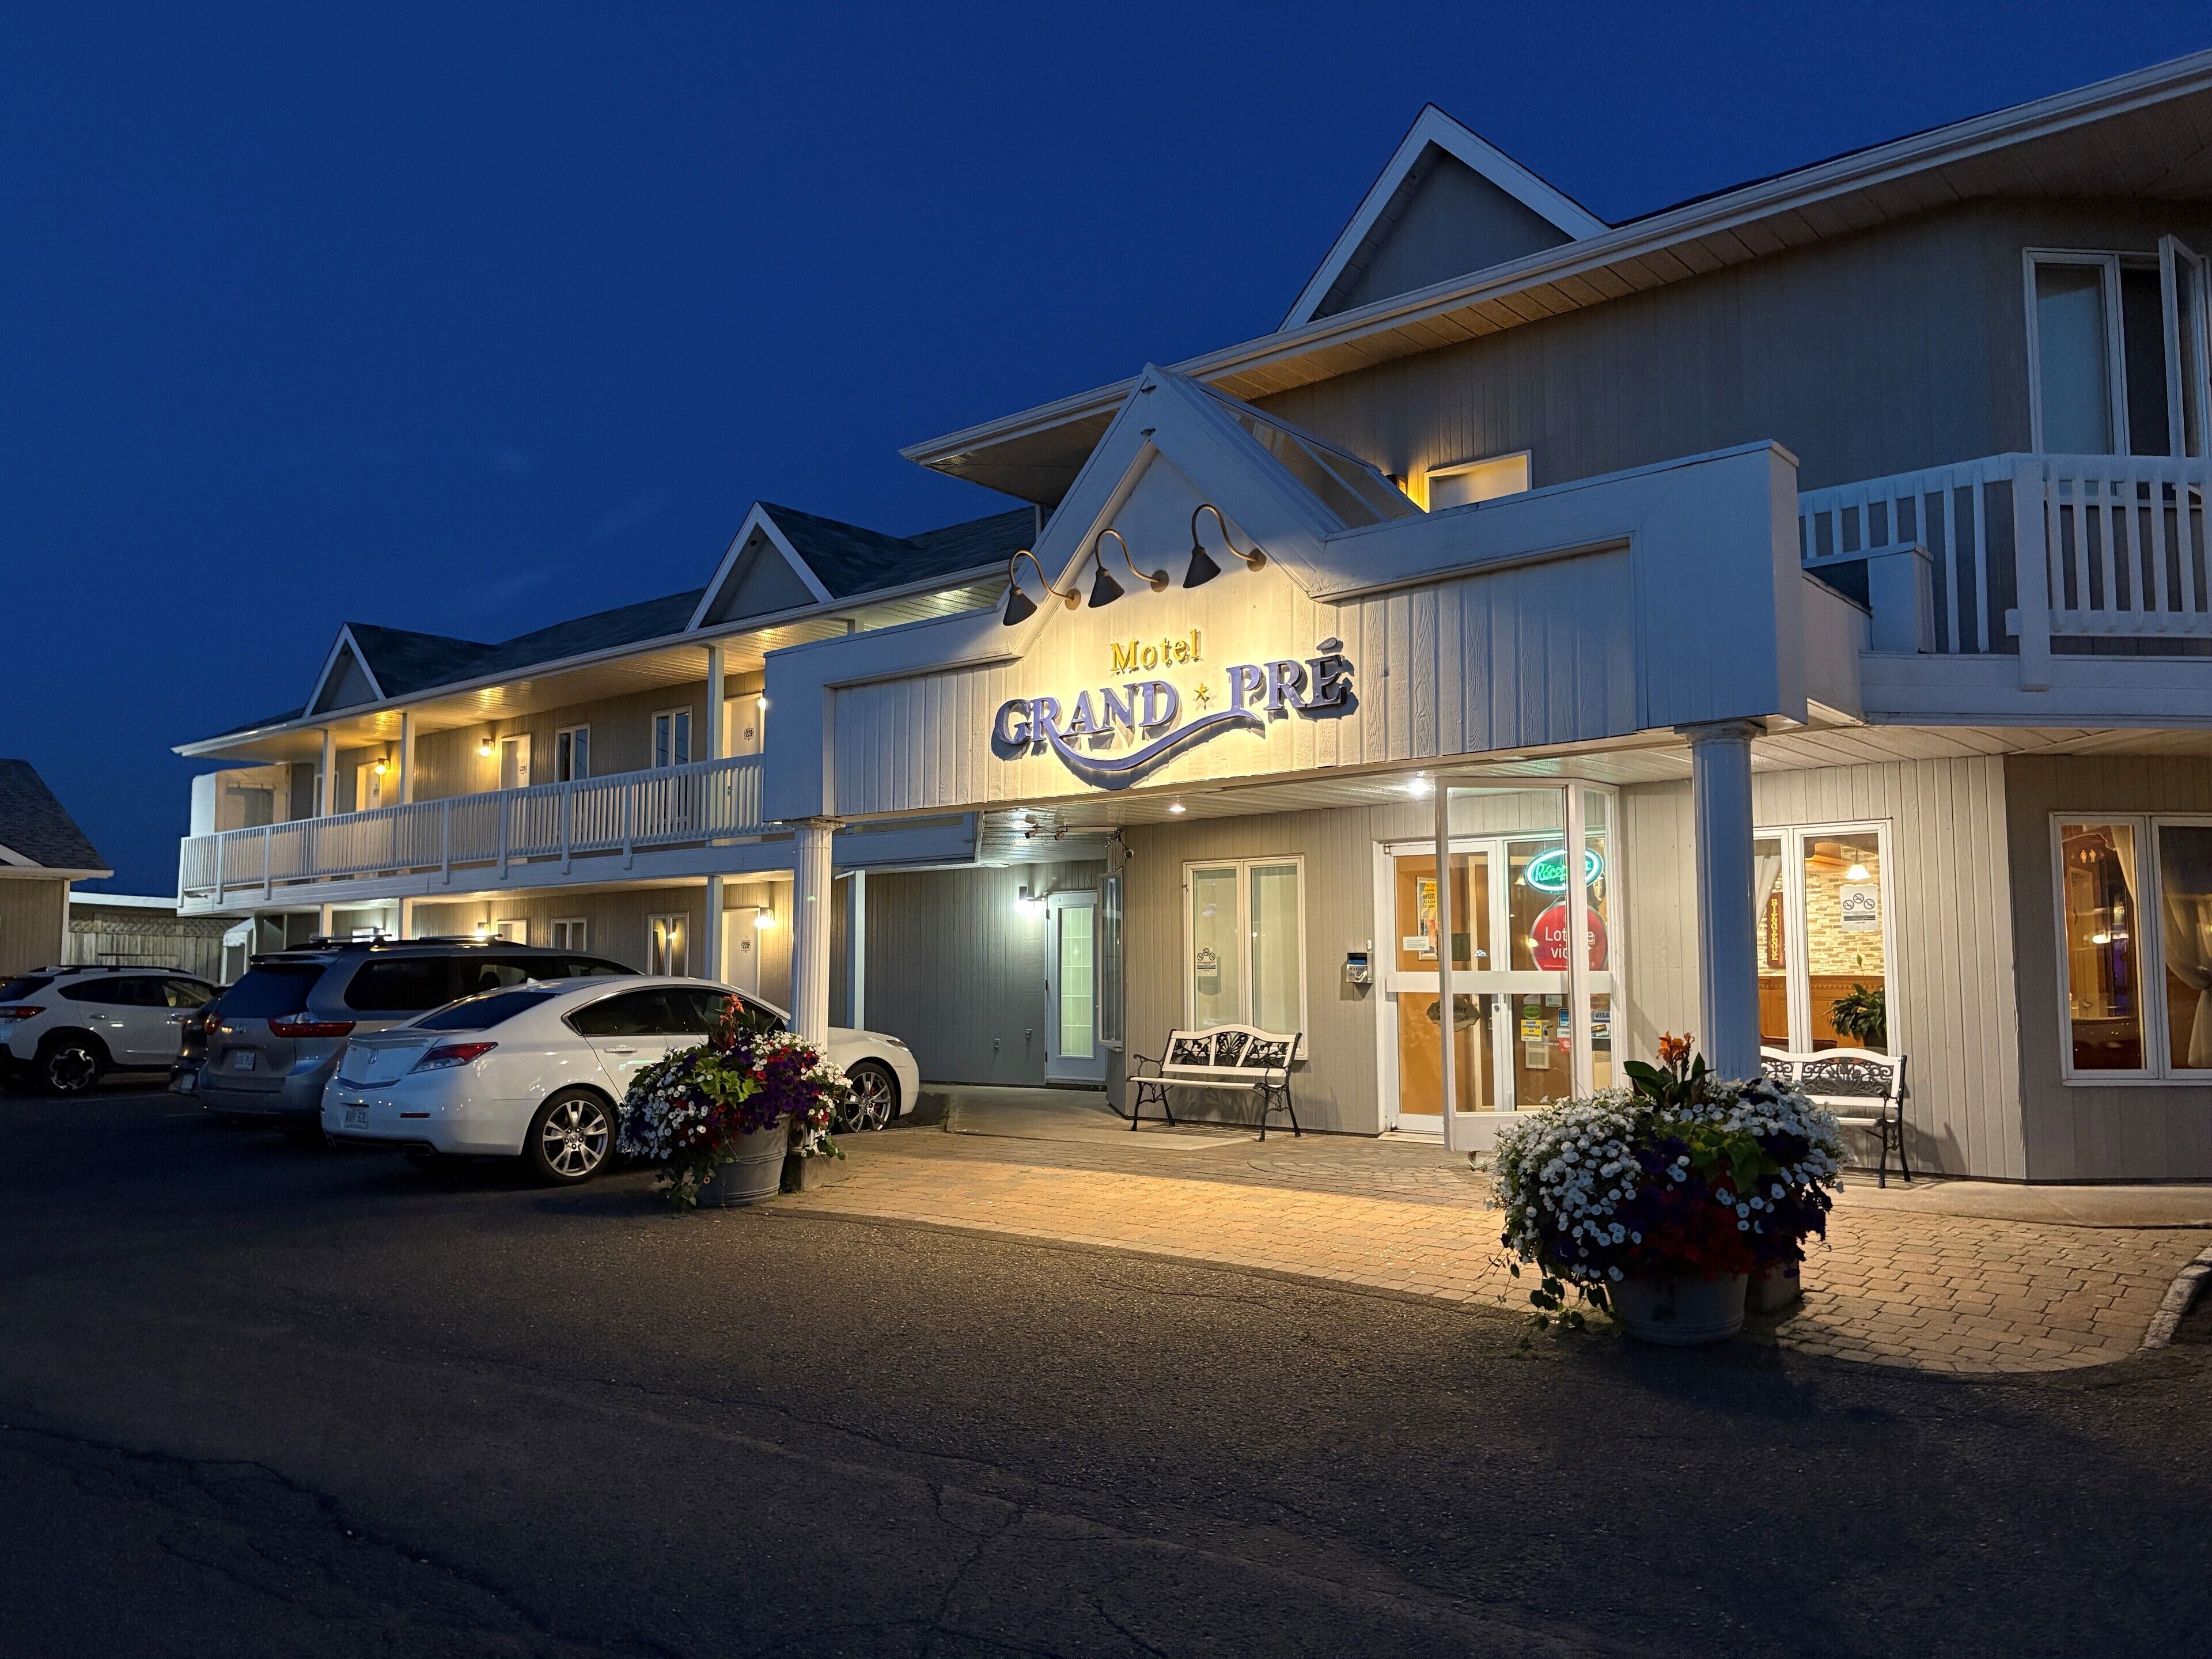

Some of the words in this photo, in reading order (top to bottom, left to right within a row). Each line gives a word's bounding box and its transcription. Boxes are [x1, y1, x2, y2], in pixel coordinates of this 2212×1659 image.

[1111, 629, 1200, 672] Motel
[993, 680, 1181, 747] GRAND
[1226, 637, 1349, 713] PRÉ
